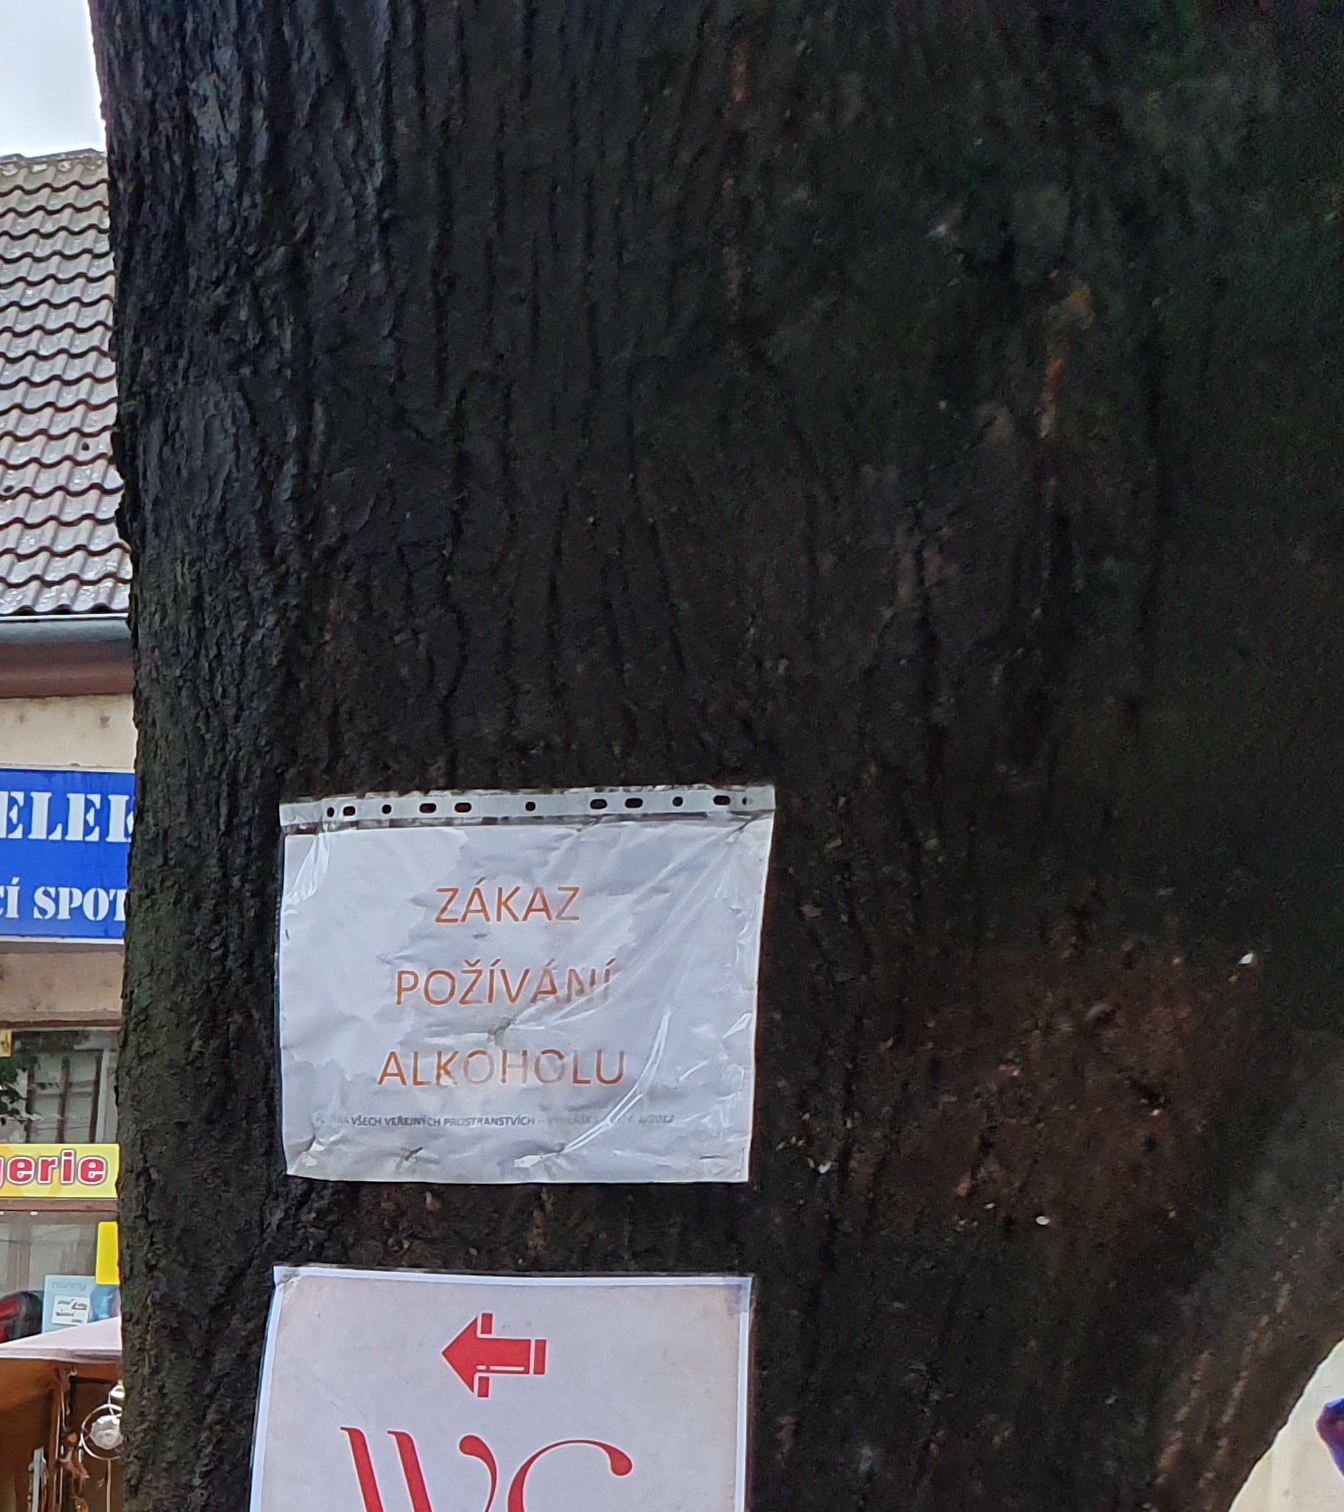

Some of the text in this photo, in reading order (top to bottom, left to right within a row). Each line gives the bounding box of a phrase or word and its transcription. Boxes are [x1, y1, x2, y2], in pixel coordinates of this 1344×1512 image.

[33, 885, 128, 922] SPOT
[434, 878, 581, 925] ZÁKAZ
[395, 957, 617, 1007] POŽÍVÁNÍ
[377, 1049, 627, 1087] ALKOHOLU
[350, 1113, 383, 1127] VŠECH
[443, 1114, 537, 1127] PROSTRANSTVÍCH
